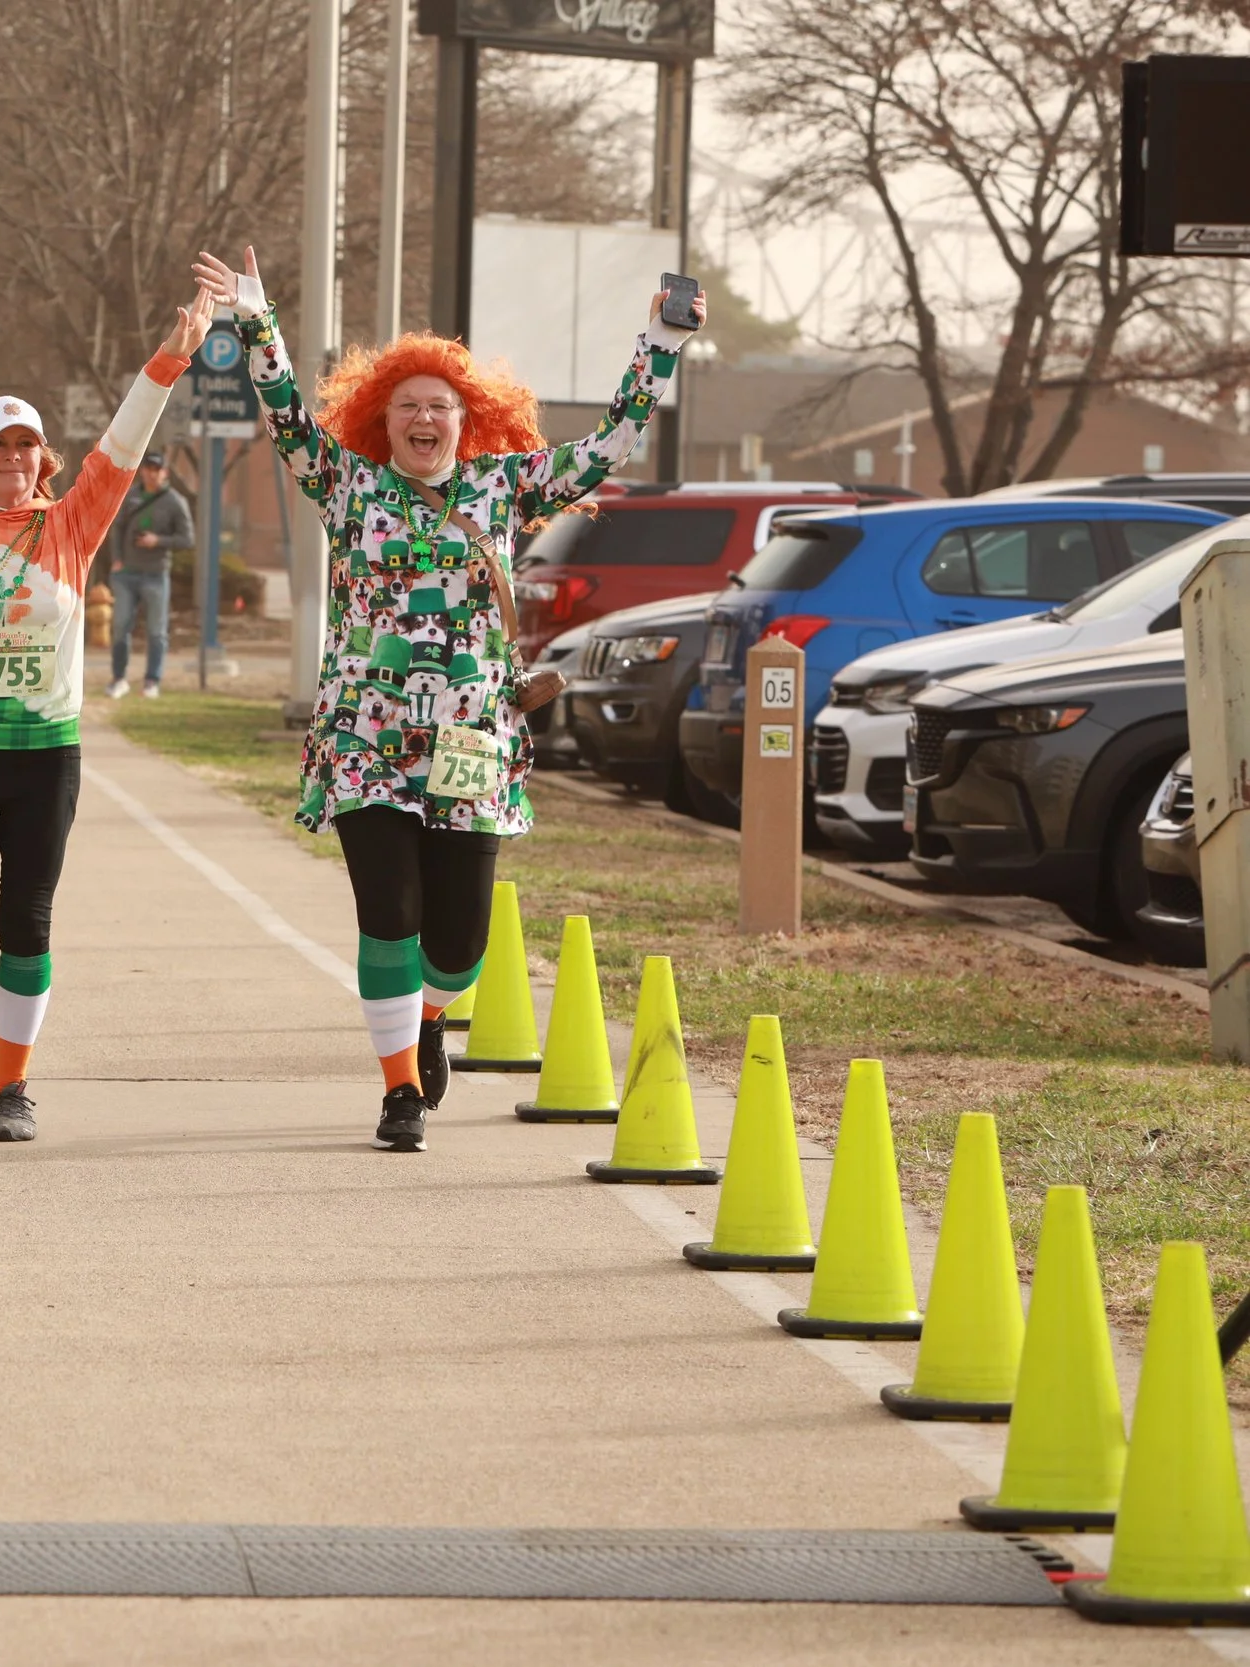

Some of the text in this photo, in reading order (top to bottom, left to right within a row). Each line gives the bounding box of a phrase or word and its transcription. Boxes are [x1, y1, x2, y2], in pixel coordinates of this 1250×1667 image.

[212, 338, 233, 363] P
[765, 680, 791, 703] 0.5
[441, 756, 487, 790] 754
